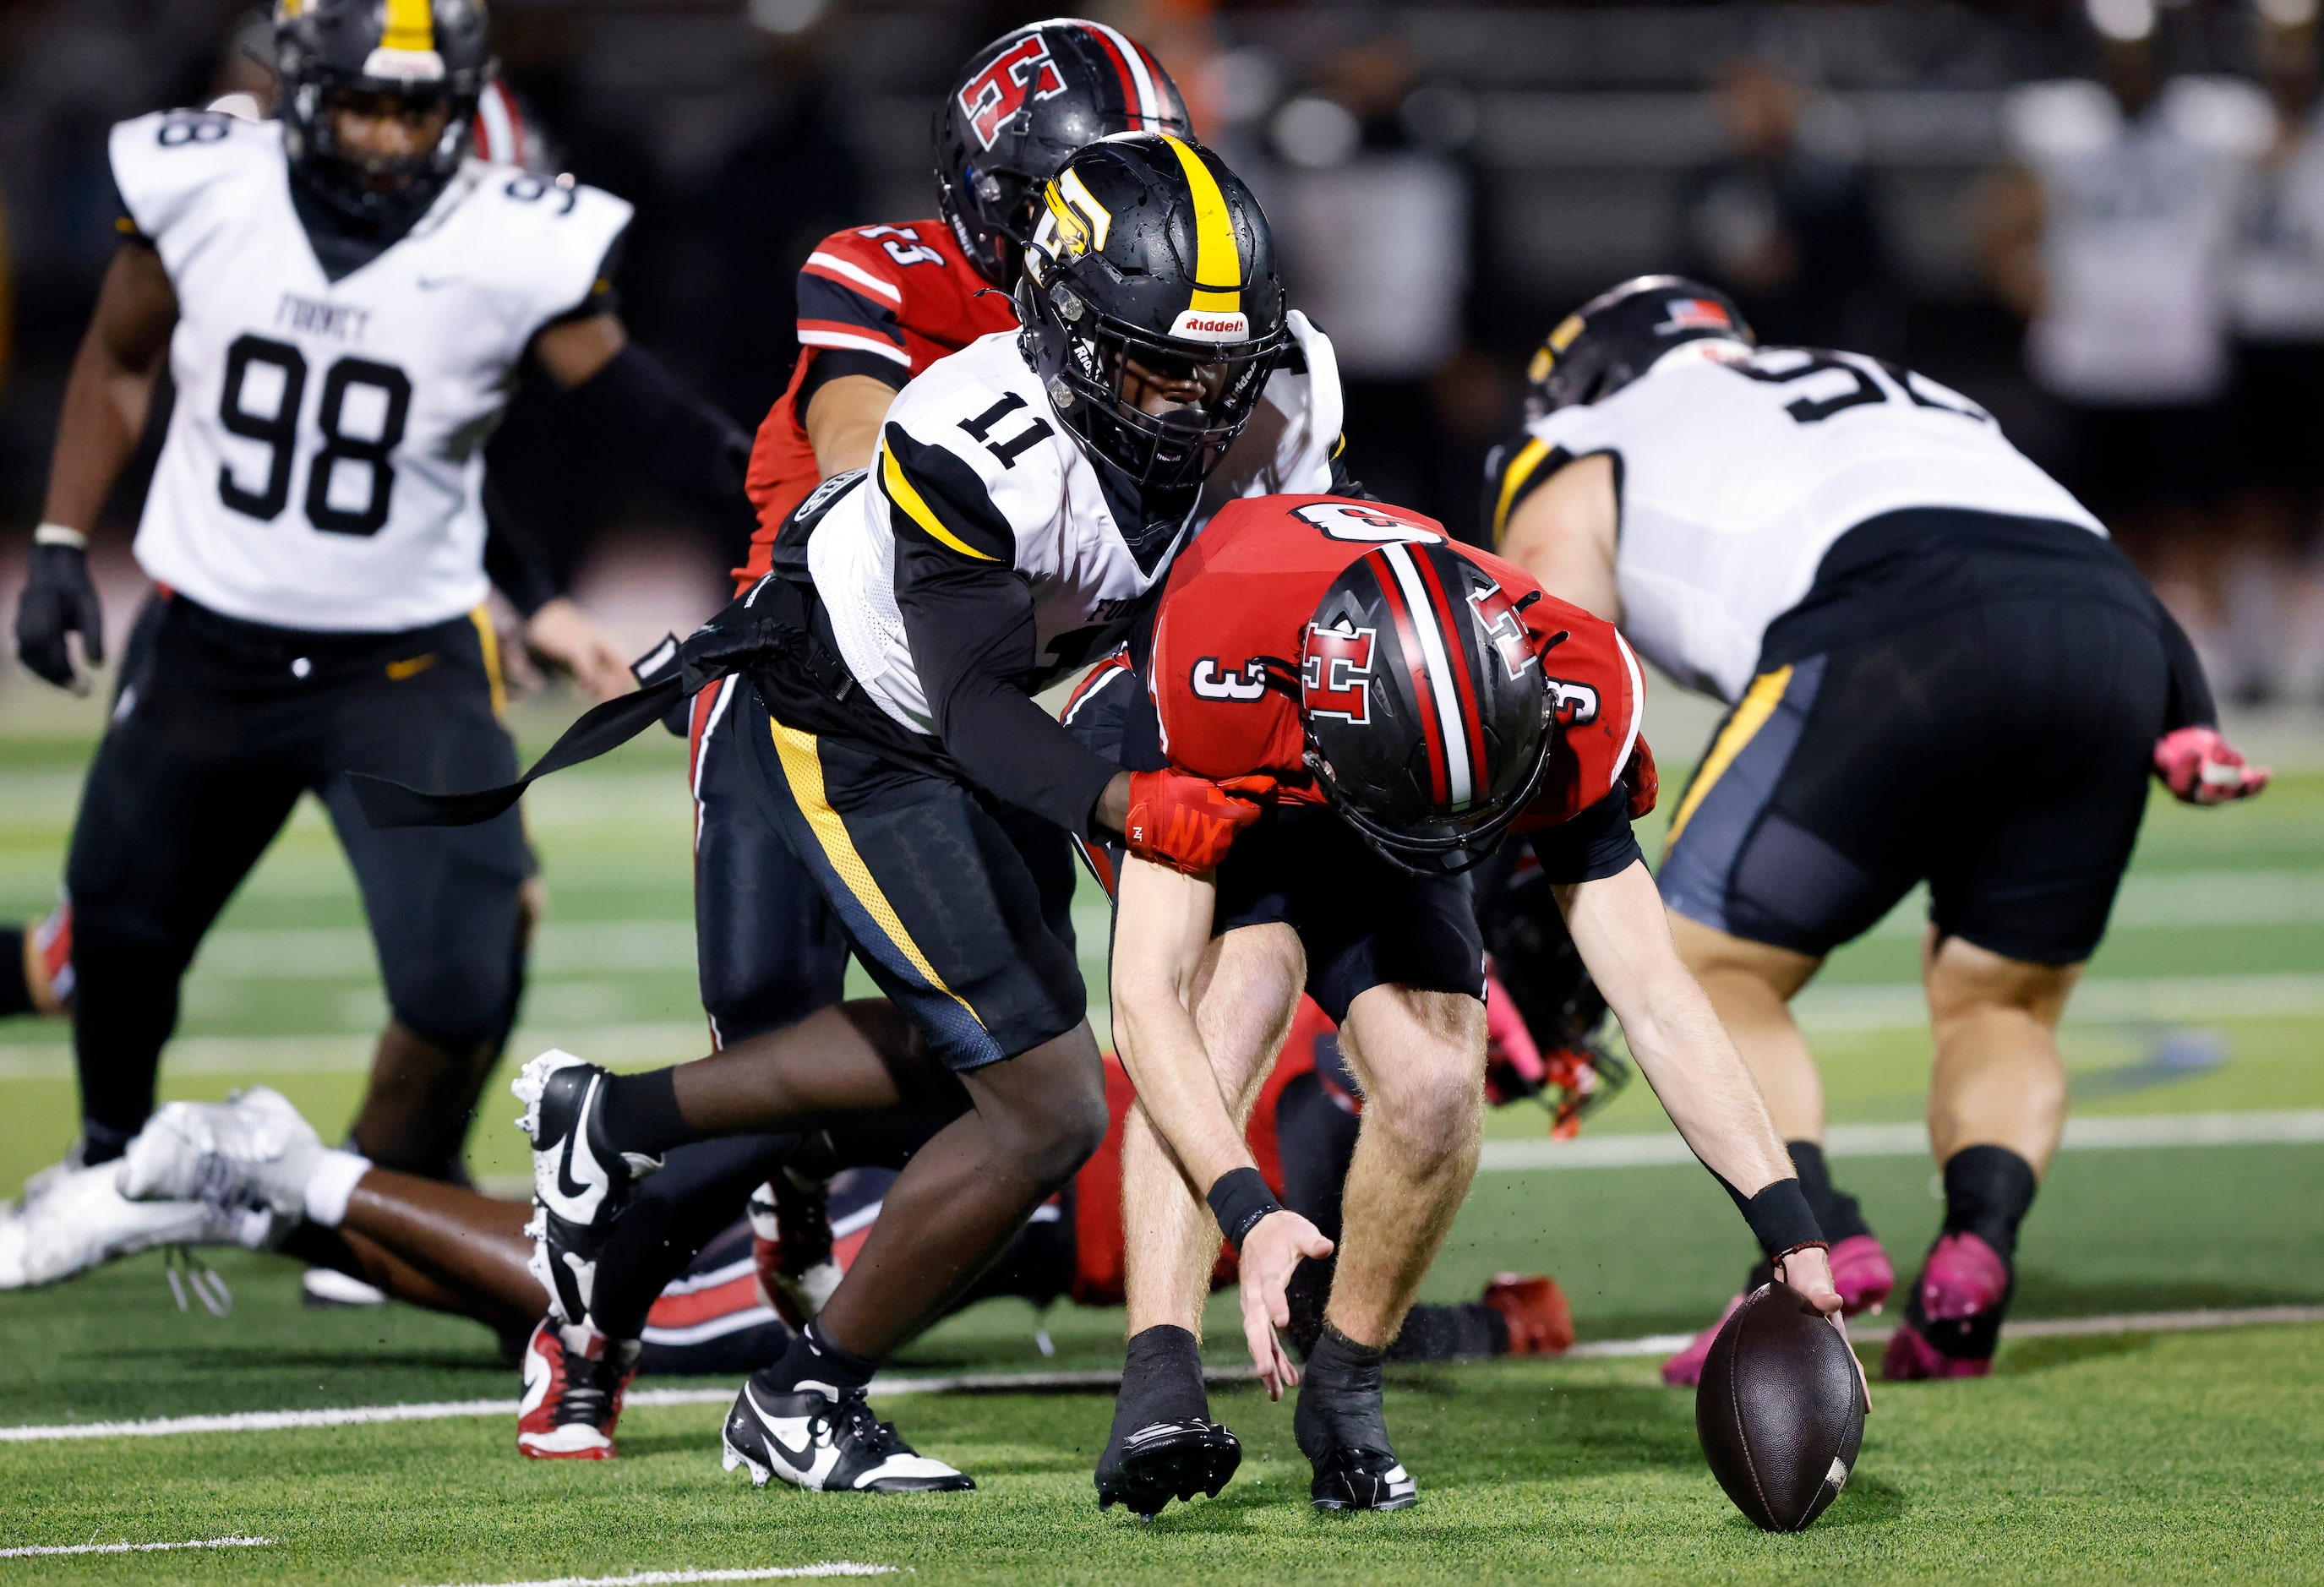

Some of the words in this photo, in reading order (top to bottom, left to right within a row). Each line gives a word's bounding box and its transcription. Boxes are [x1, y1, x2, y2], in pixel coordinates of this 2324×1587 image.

[1186, 318, 1243, 332] Riddell
[218, 334, 412, 536] 98
[956, 391, 1056, 470] 11
[1190, 656, 1268, 703] 3
[1301, 622, 1377, 725] H
